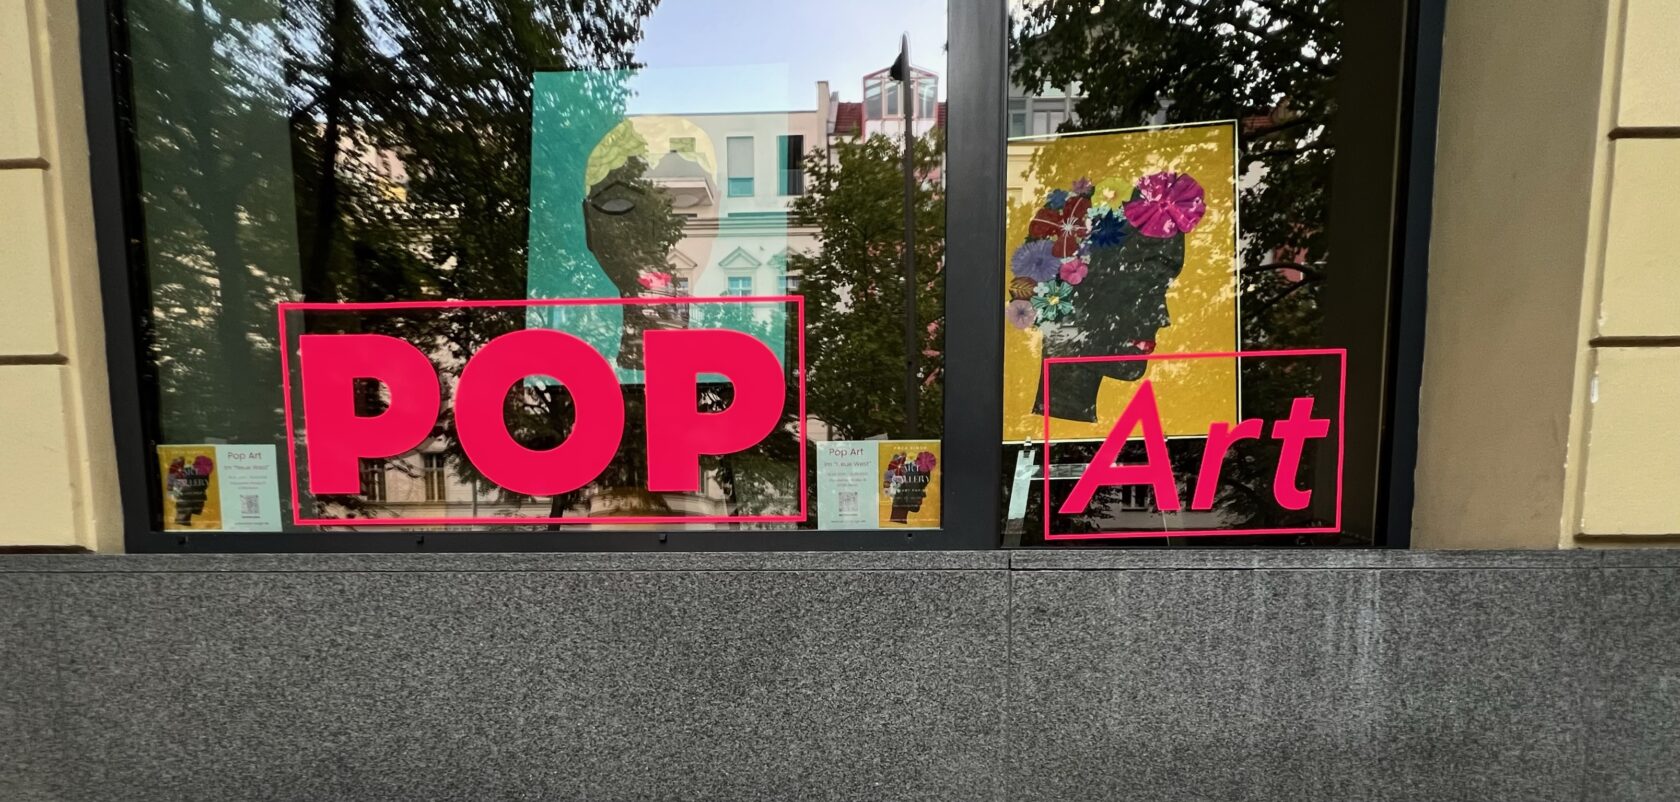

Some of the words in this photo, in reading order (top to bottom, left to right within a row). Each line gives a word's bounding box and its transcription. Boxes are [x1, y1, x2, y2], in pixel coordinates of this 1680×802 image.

[300, 330, 785, 495] POP
[1060, 380, 1330, 514] Art
[227, 452, 246, 461] Pop
[829, 448, 848, 458] Pop
[850, 448, 864, 456] Art
